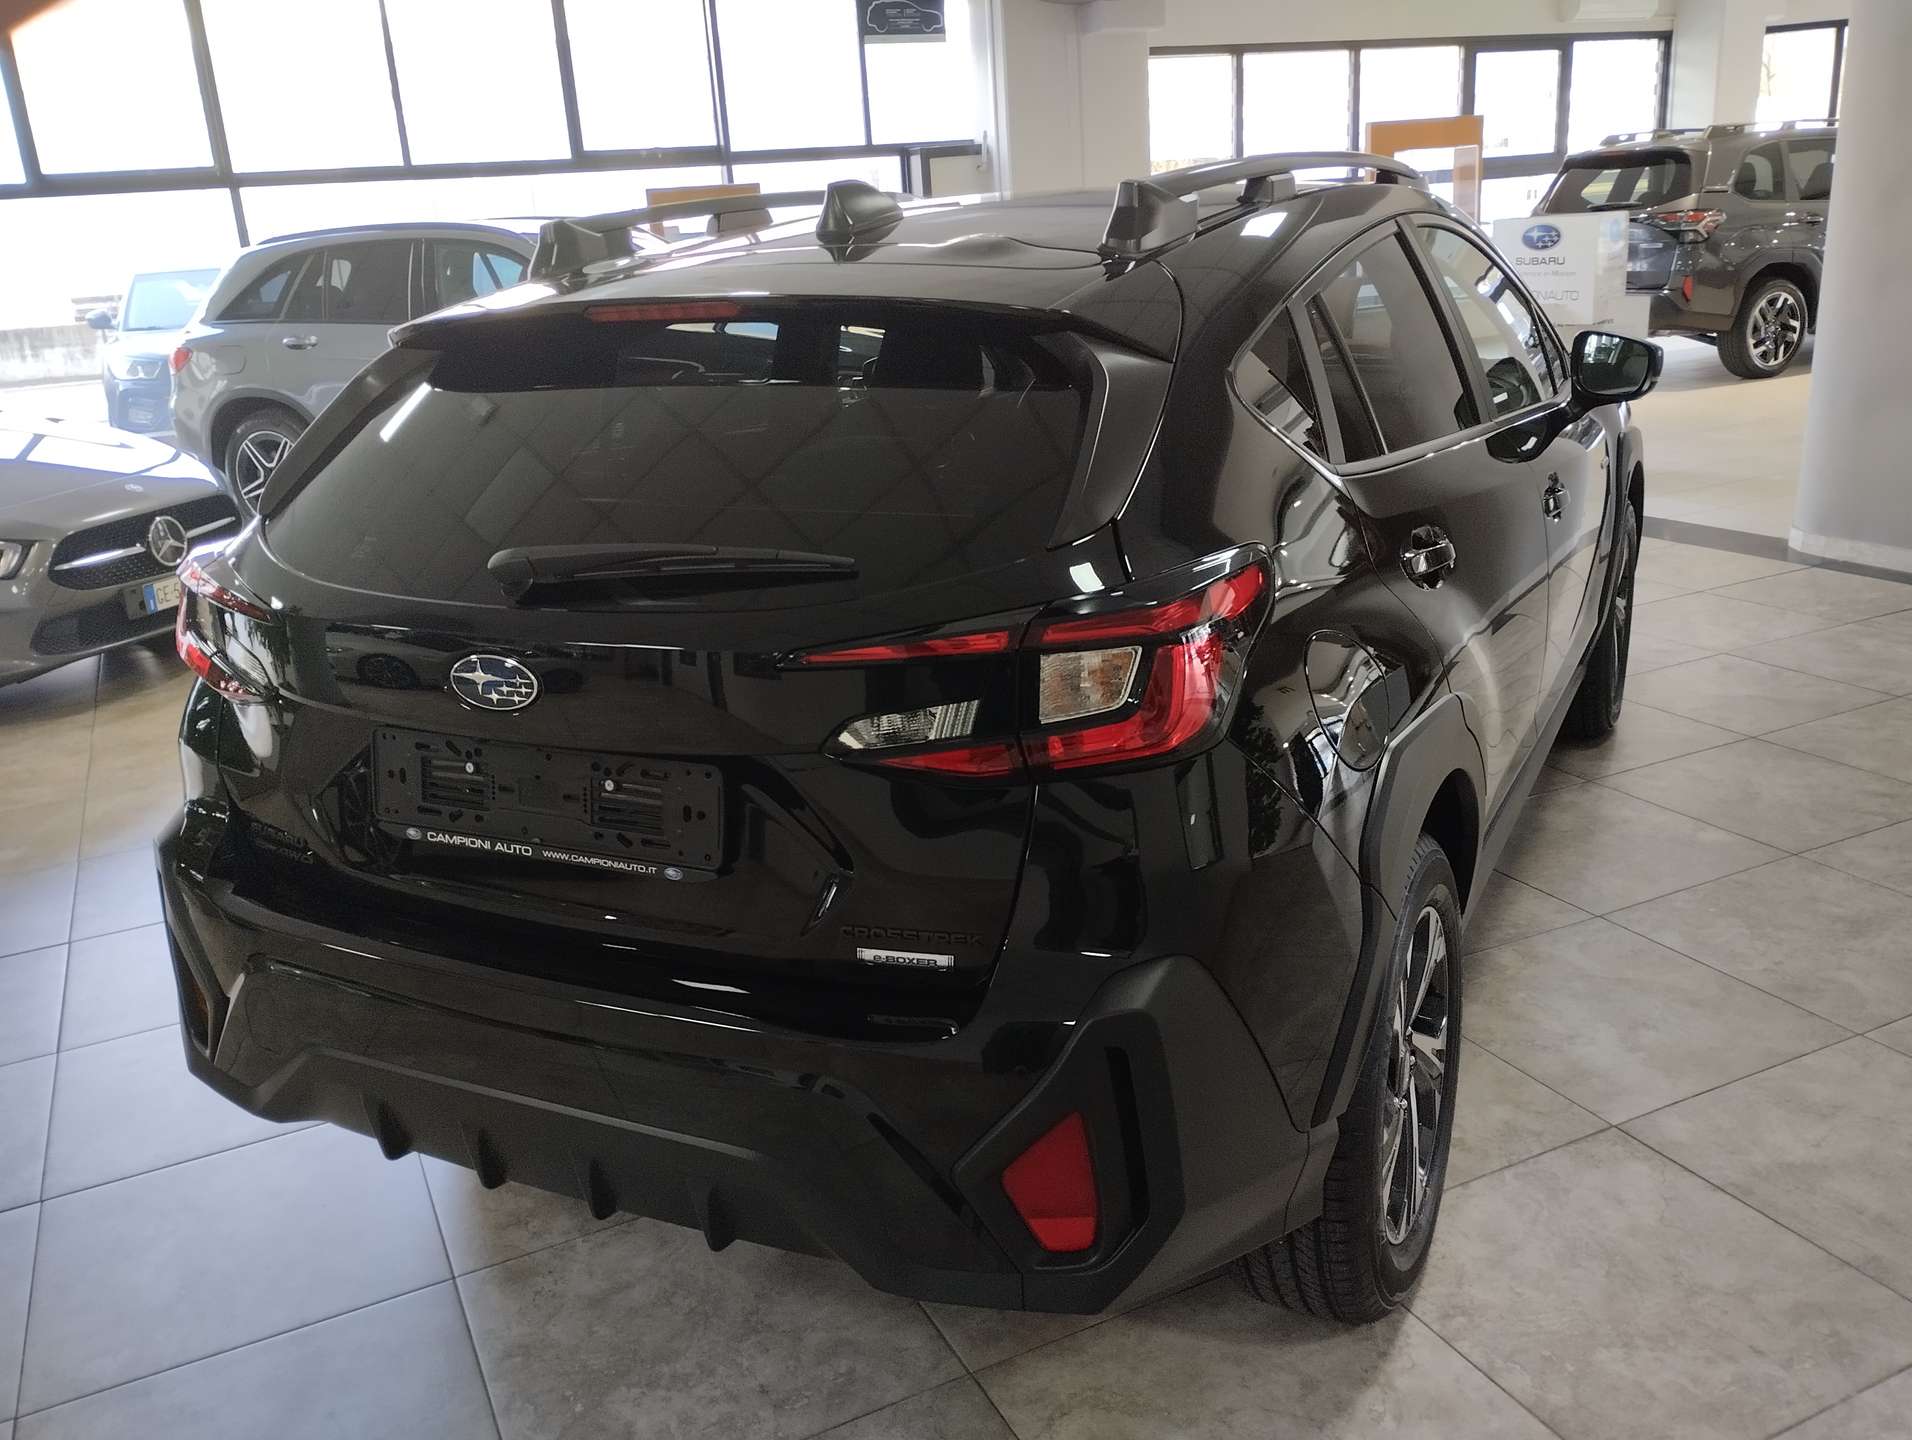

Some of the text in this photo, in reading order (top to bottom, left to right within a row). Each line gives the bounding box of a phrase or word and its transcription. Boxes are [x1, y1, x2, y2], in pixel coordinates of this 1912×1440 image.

[1515, 256, 1566, 266] SUBARU
[426, 831, 658, 874] CAMPIONI AUTO WWW.CAMPIONIAUTO.IT
[840, 925, 984, 946] CROSSTREK
